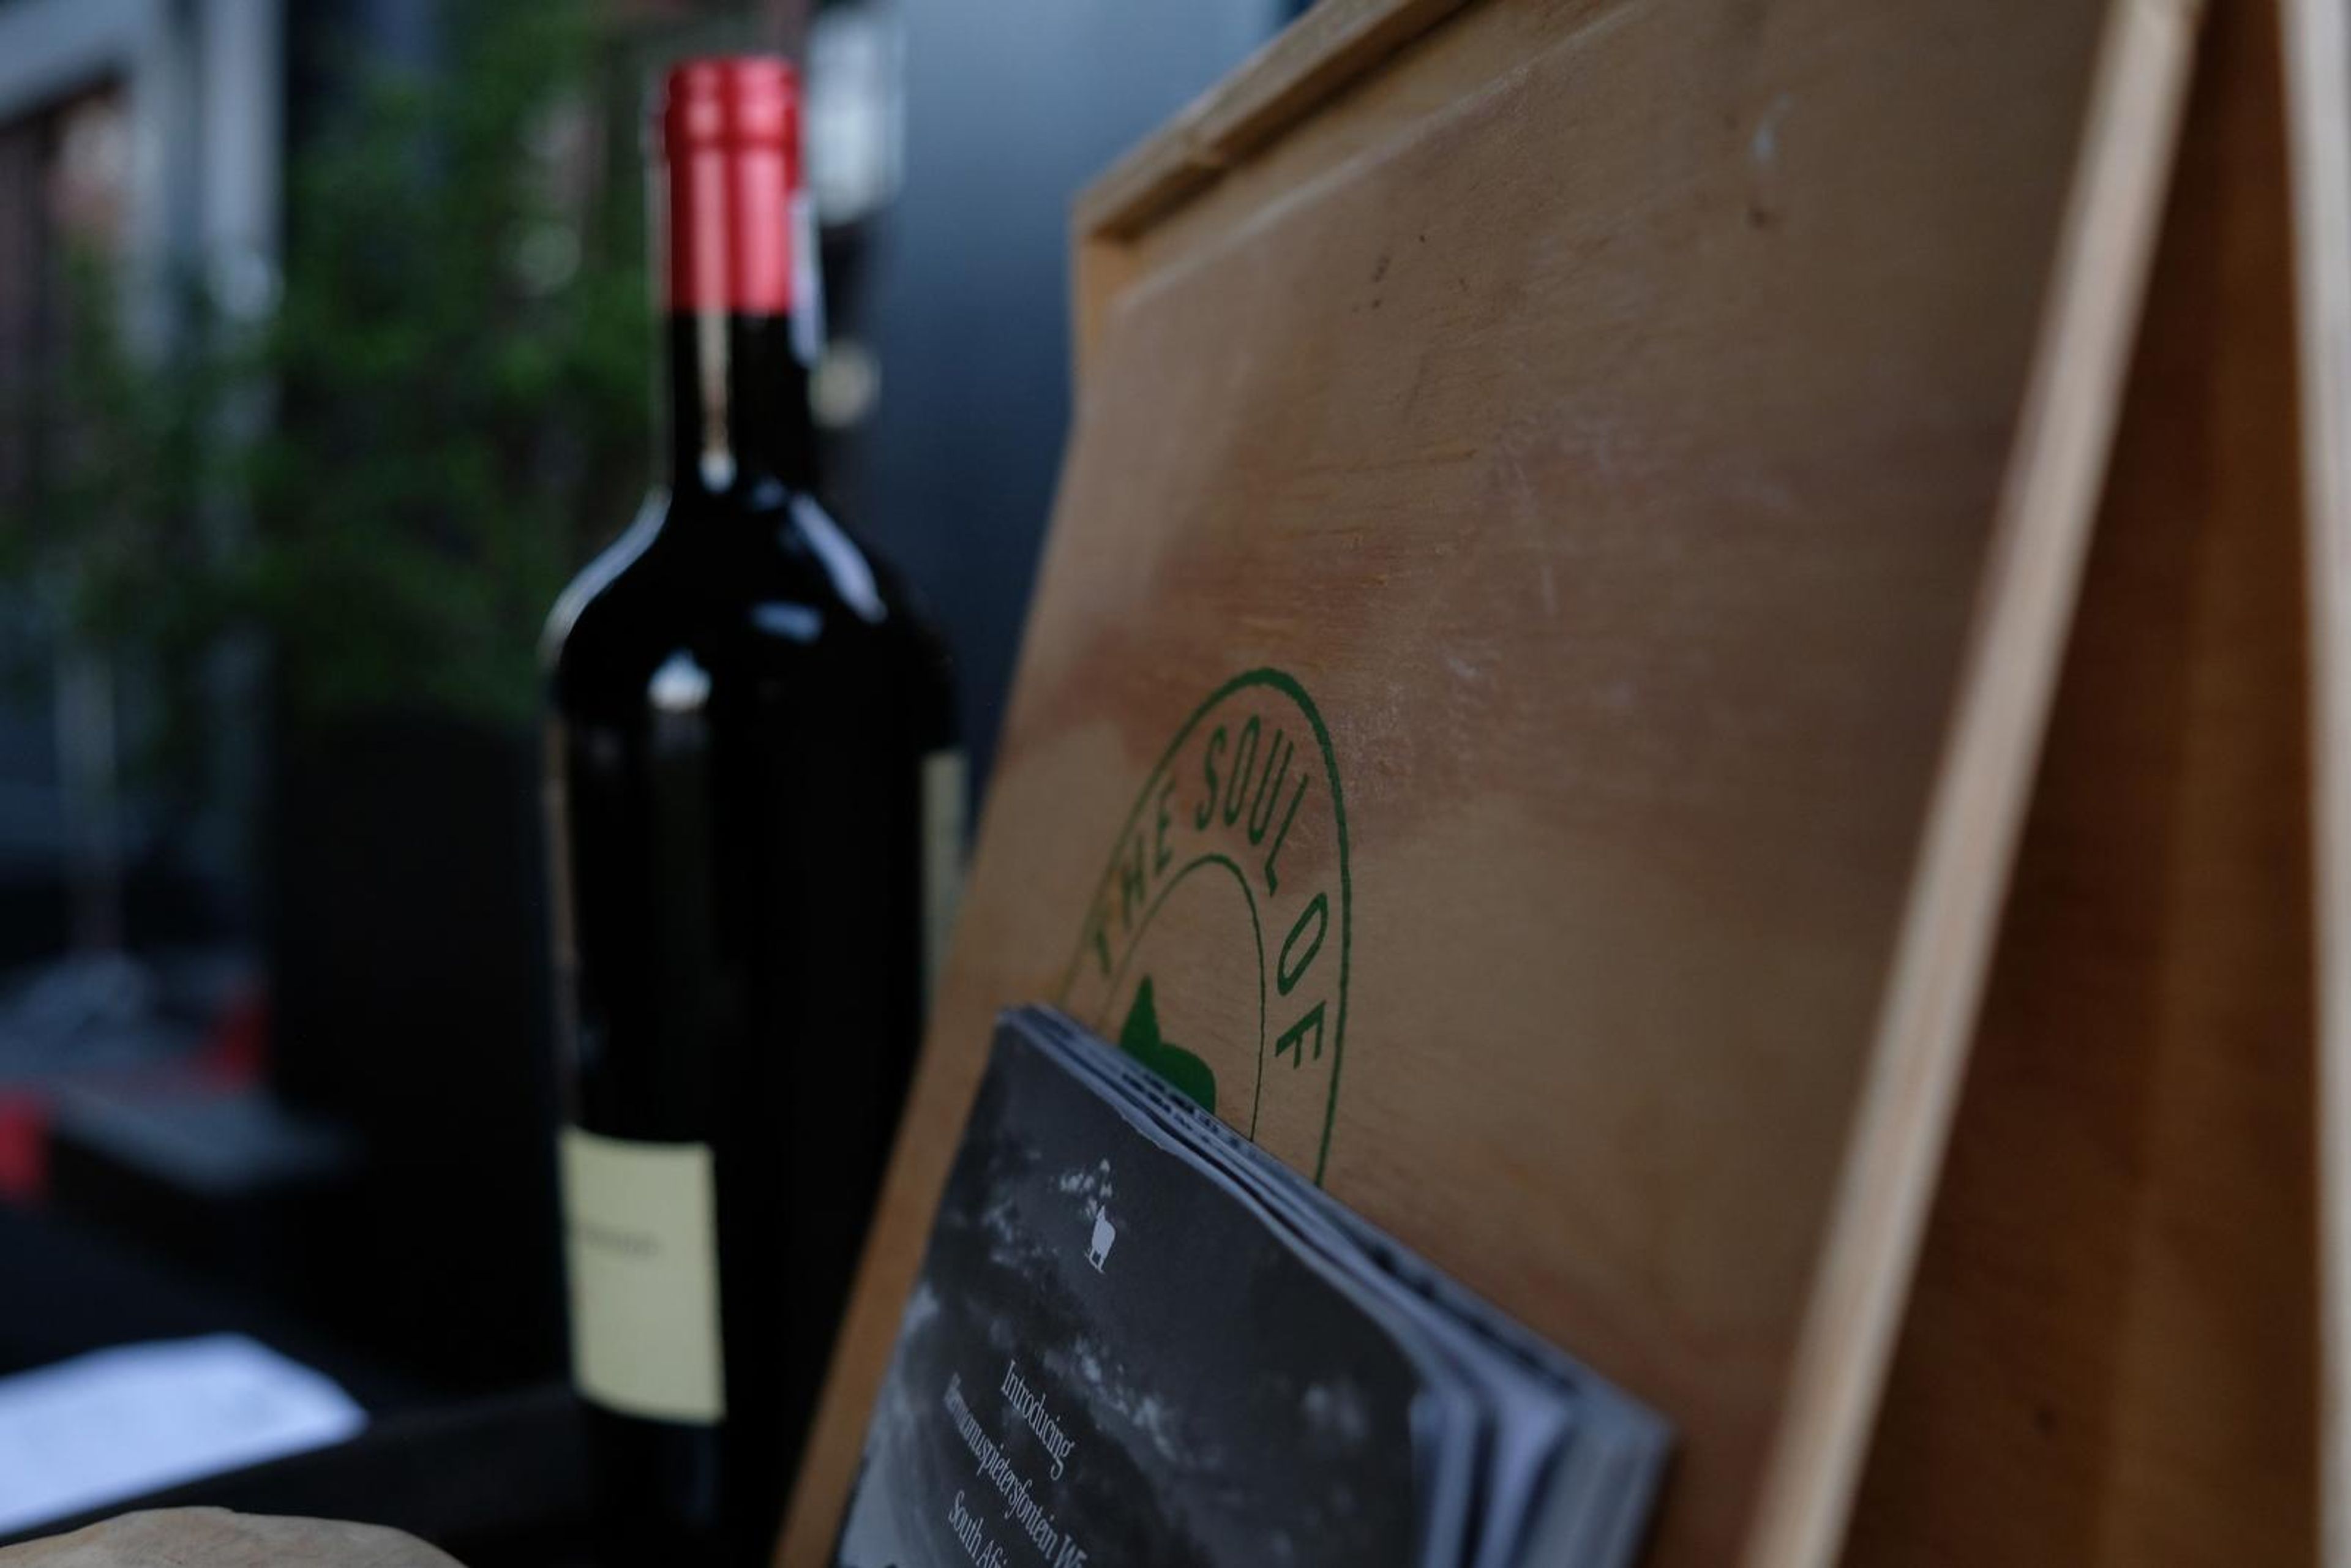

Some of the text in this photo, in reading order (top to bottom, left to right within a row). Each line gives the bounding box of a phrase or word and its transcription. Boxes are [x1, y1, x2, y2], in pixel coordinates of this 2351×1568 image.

[1092, 715, 1328, 1069] THE SOUL OF
[1000, 1359, 1076, 1481] Introducing
[948, 1490, 1008, 1568] South Af
[1052, 1533, 1088, 1568] W
